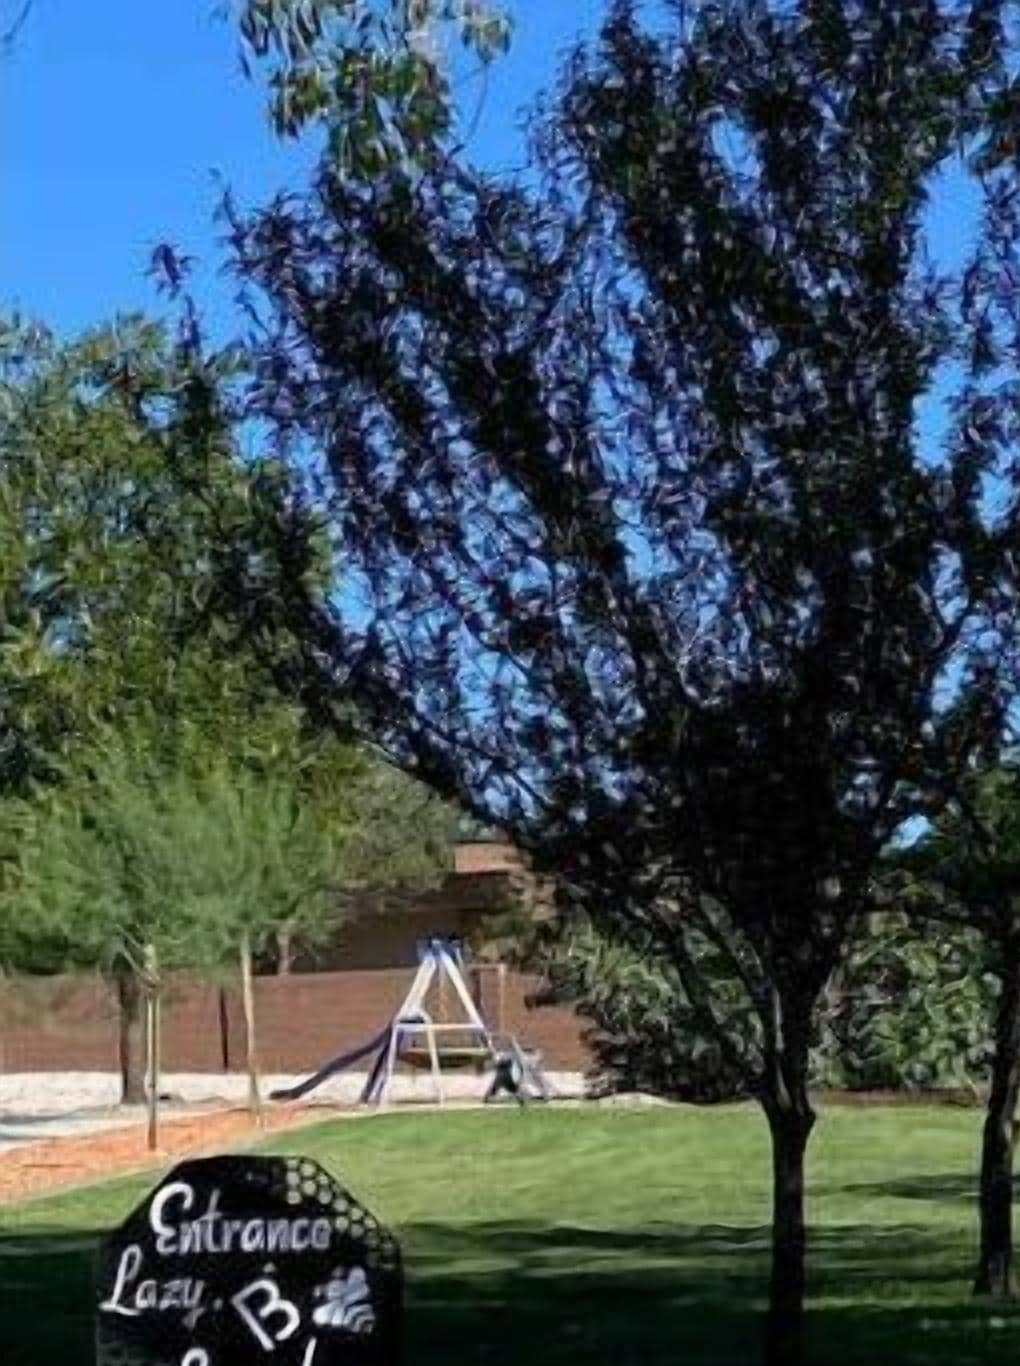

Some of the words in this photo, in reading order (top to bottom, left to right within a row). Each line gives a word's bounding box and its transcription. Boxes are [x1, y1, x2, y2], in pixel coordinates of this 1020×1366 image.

[150, 1181, 332, 1255] Entrance
[98, 1244, 206, 1330] Lazy
[231, 1279, 301, 1351] B
